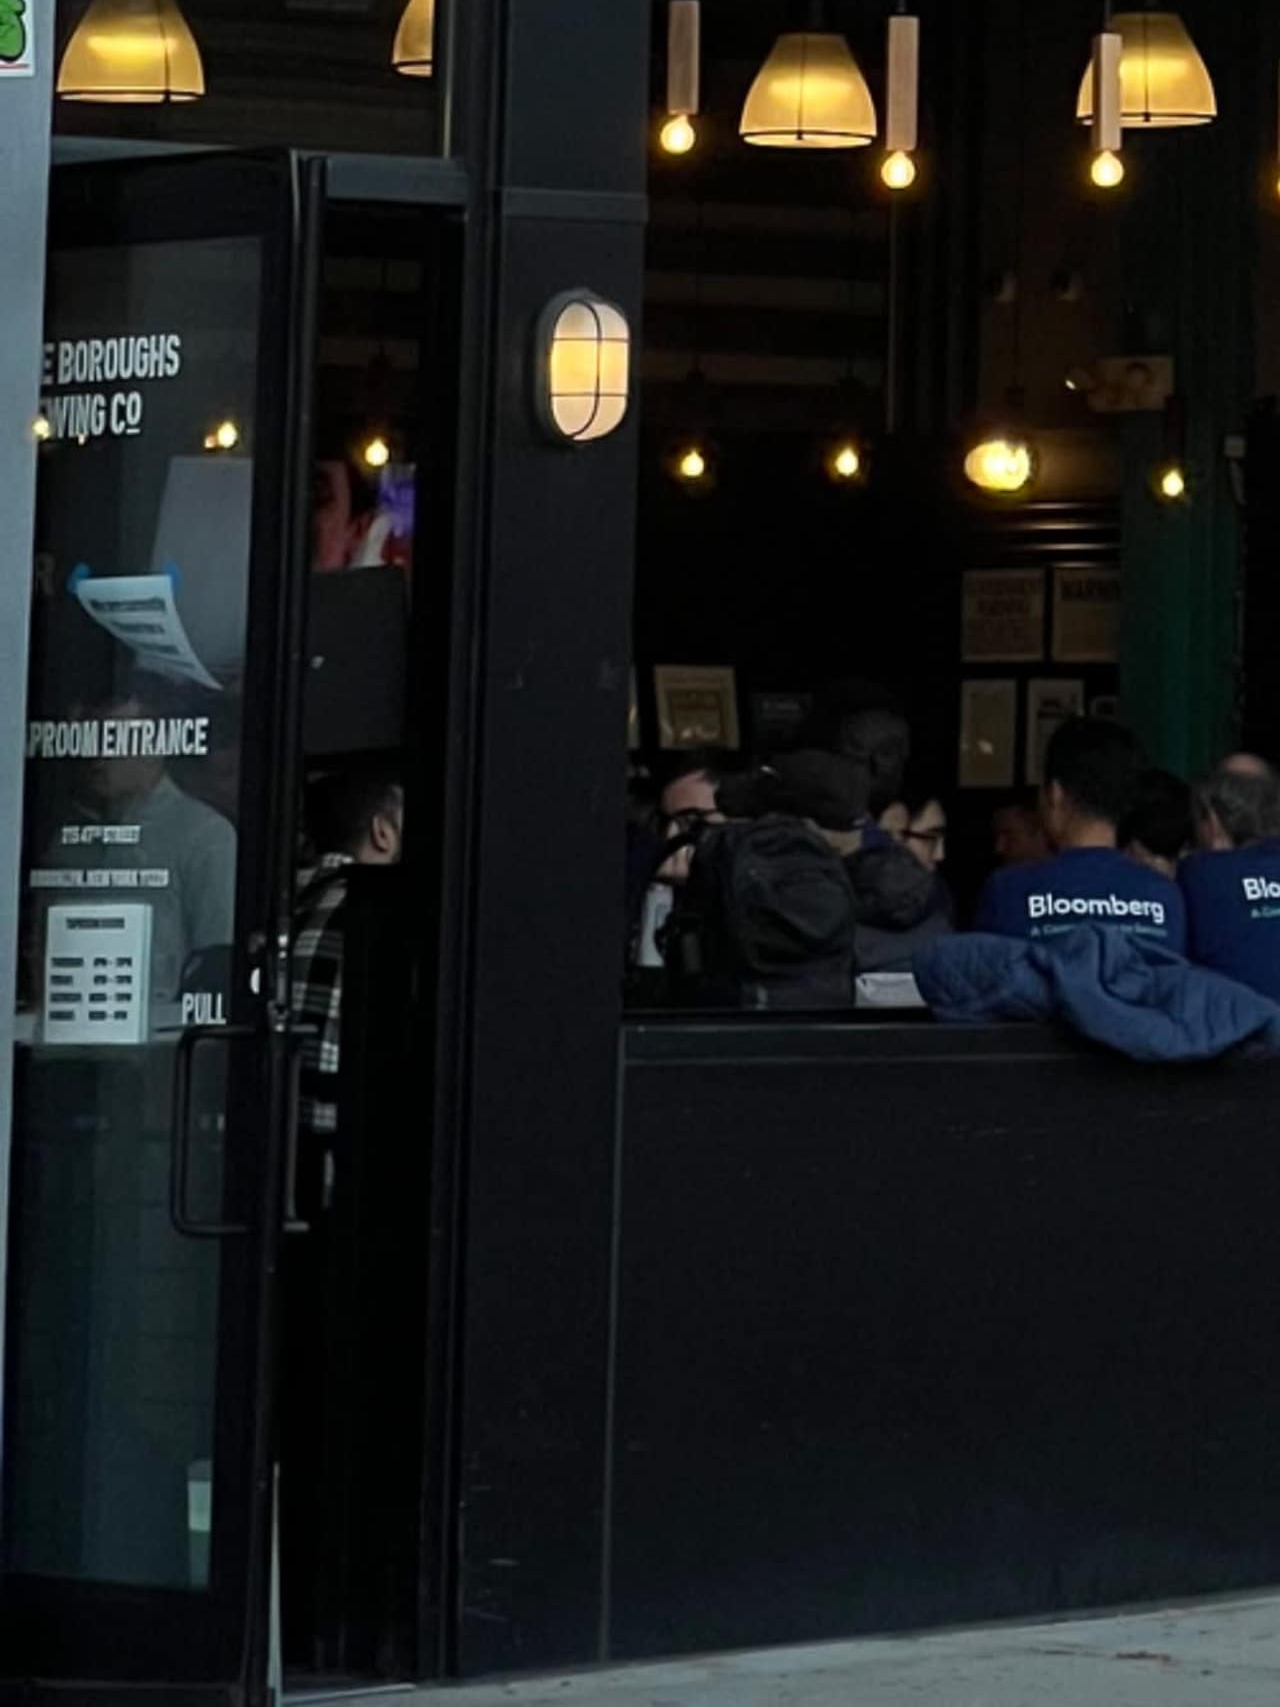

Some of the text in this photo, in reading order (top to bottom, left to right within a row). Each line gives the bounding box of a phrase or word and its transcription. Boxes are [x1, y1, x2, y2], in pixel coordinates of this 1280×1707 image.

[57, 334, 181, 385] BOROUGHS
[27, 716, 210, 759] PROOM ENTRANCE
[1028, 890, 1165, 925] Bloomberg
[181, 991, 227, 1025] PULL
